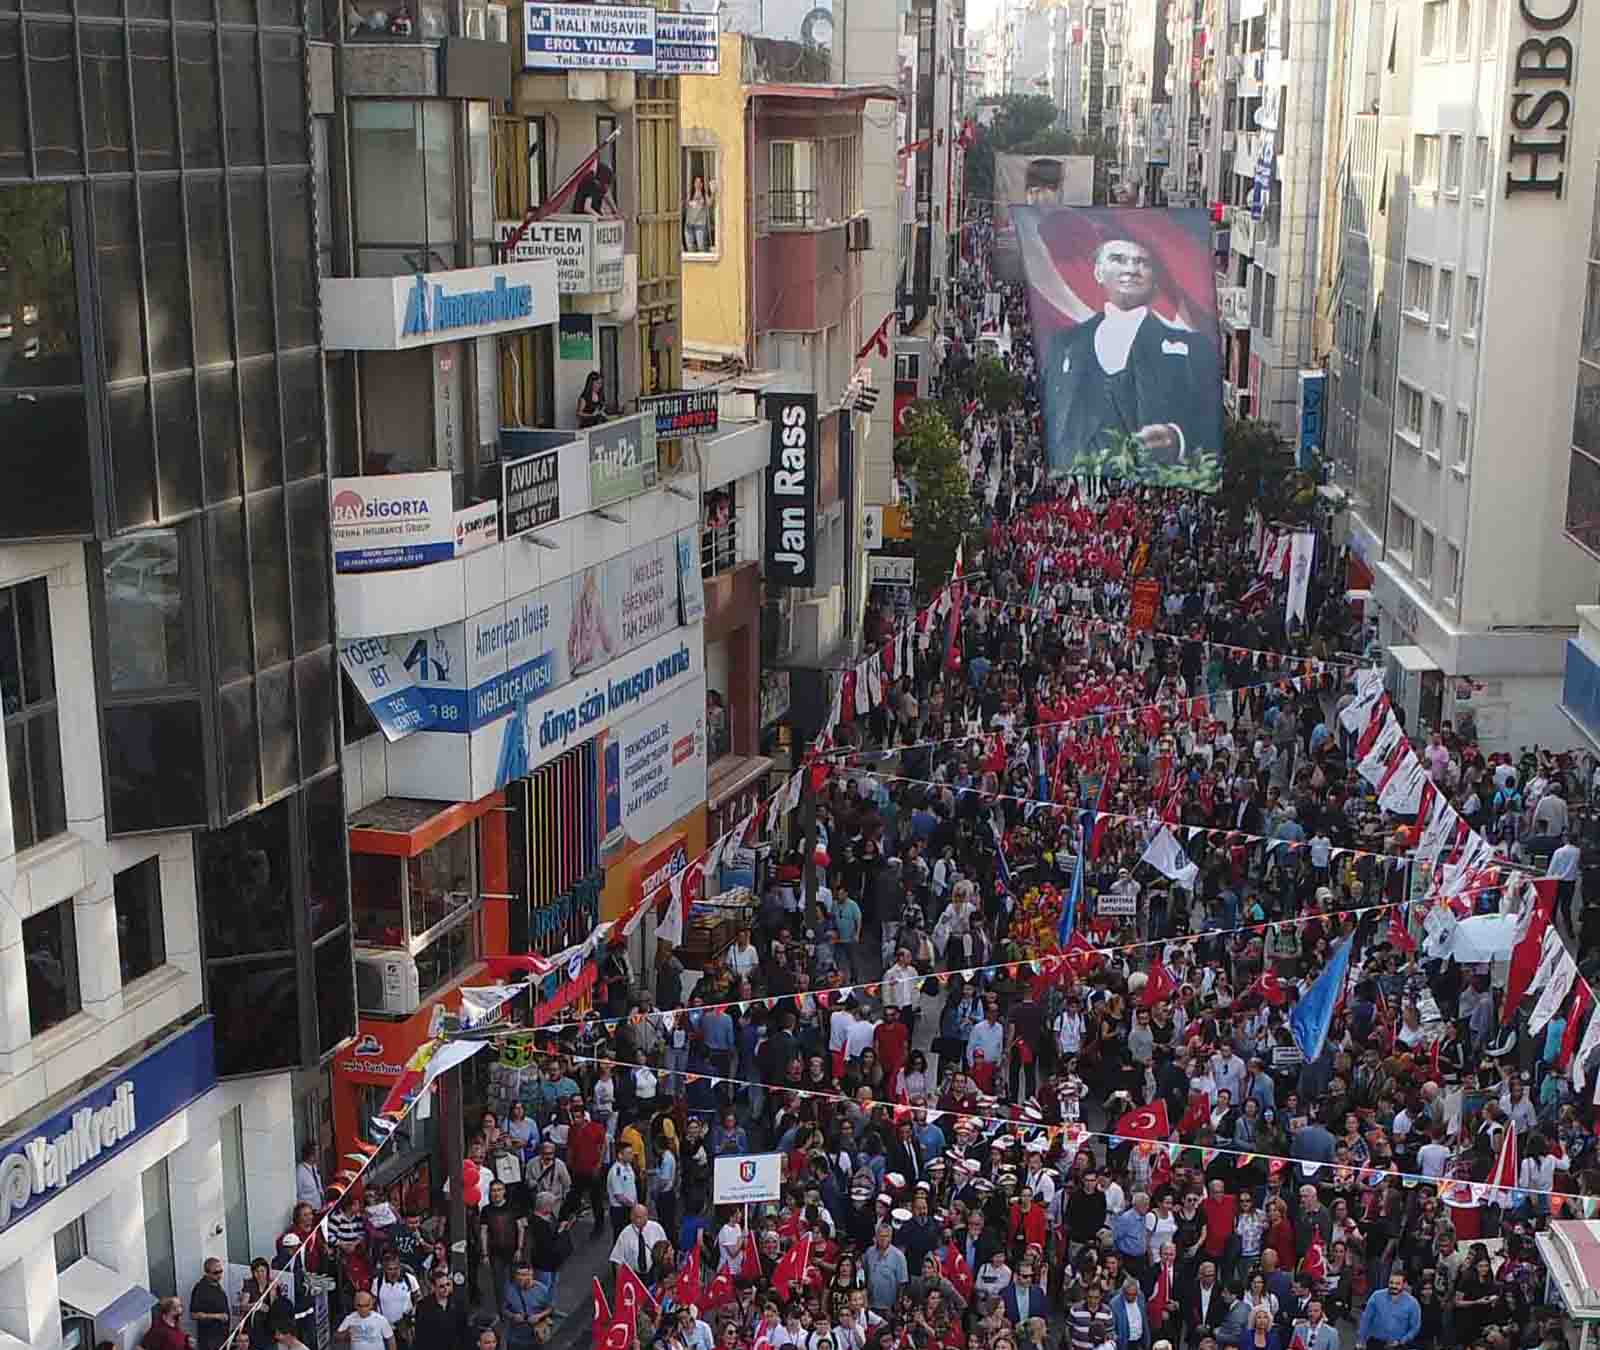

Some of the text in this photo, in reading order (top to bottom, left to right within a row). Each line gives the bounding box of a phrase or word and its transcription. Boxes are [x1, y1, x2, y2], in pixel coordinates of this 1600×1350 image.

[544, 38, 635, 53] EROL YILMAZ
[510, 456, 555, 493] AVUKAT
[774, 405, 807, 575] Jan Rass
[335, 496, 430, 521] RAY SİGORTA
[475, 602, 550, 658] American House
[341, 639, 389, 667] TOEFL
[521, 664, 552, 698] KURSU
[539, 705, 577, 750] dünya
[578, 687, 606, 728] sizin
[607, 666, 655, 712] konuşun
[24, 1081, 137, 1195] YapıKredi
